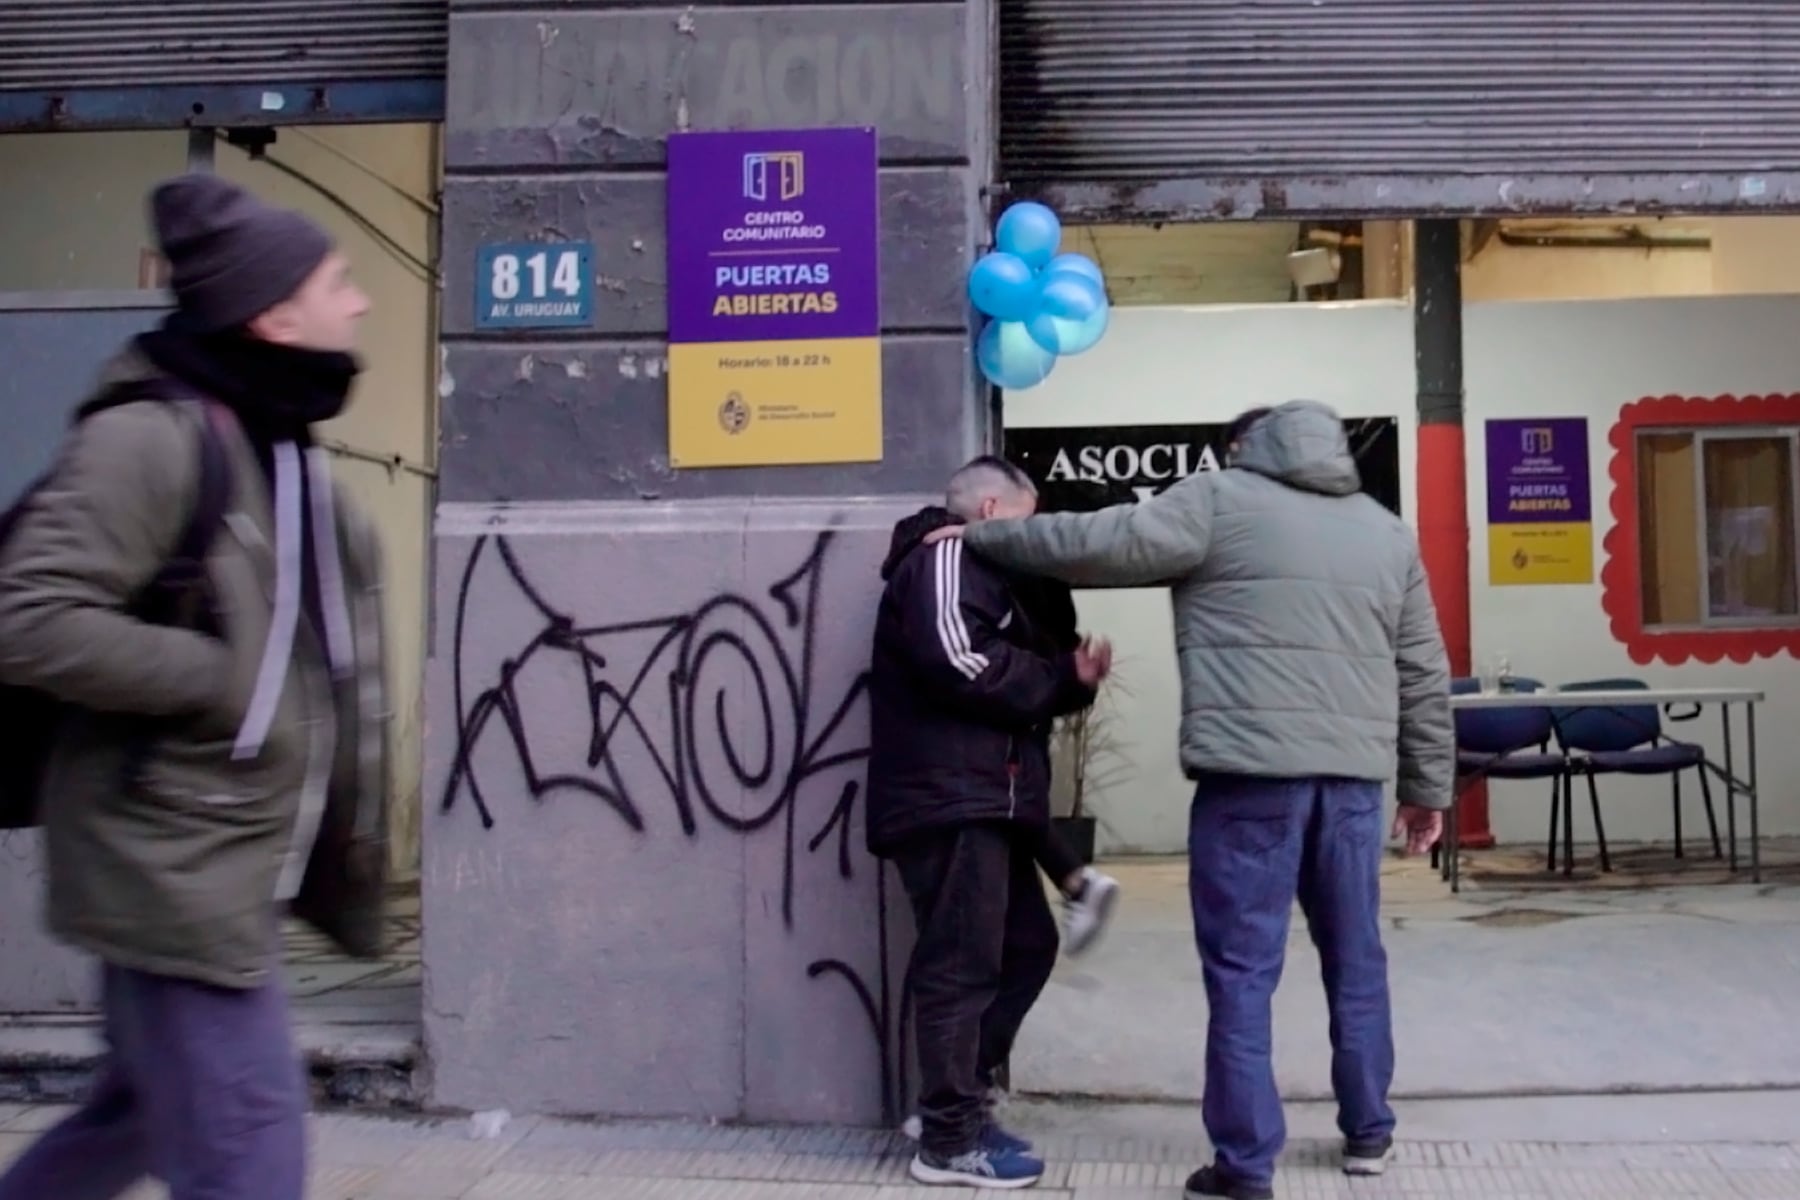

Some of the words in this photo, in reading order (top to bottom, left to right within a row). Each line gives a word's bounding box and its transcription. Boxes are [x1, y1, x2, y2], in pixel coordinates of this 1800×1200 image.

[744, 210, 804, 226] CENTRO
[722, 225, 826, 242] COMUNITARIO
[491, 251, 581, 300] 814
[715, 263, 831, 288] PUERTAS
[514, 302, 581, 318] URUGUAY
[712, 291, 839, 317] ABIERTAS
[718, 356, 772, 369] Horario:
[792, 358, 800, 366] a
[803, 354, 819, 366] 22
[822, 354, 831, 366] h
[1045, 443, 1231, 484] ASOCIA
[1509, 484, 1567, 497] PUERTAS
[1509, 498, 1572, 511] ABIERTAS
